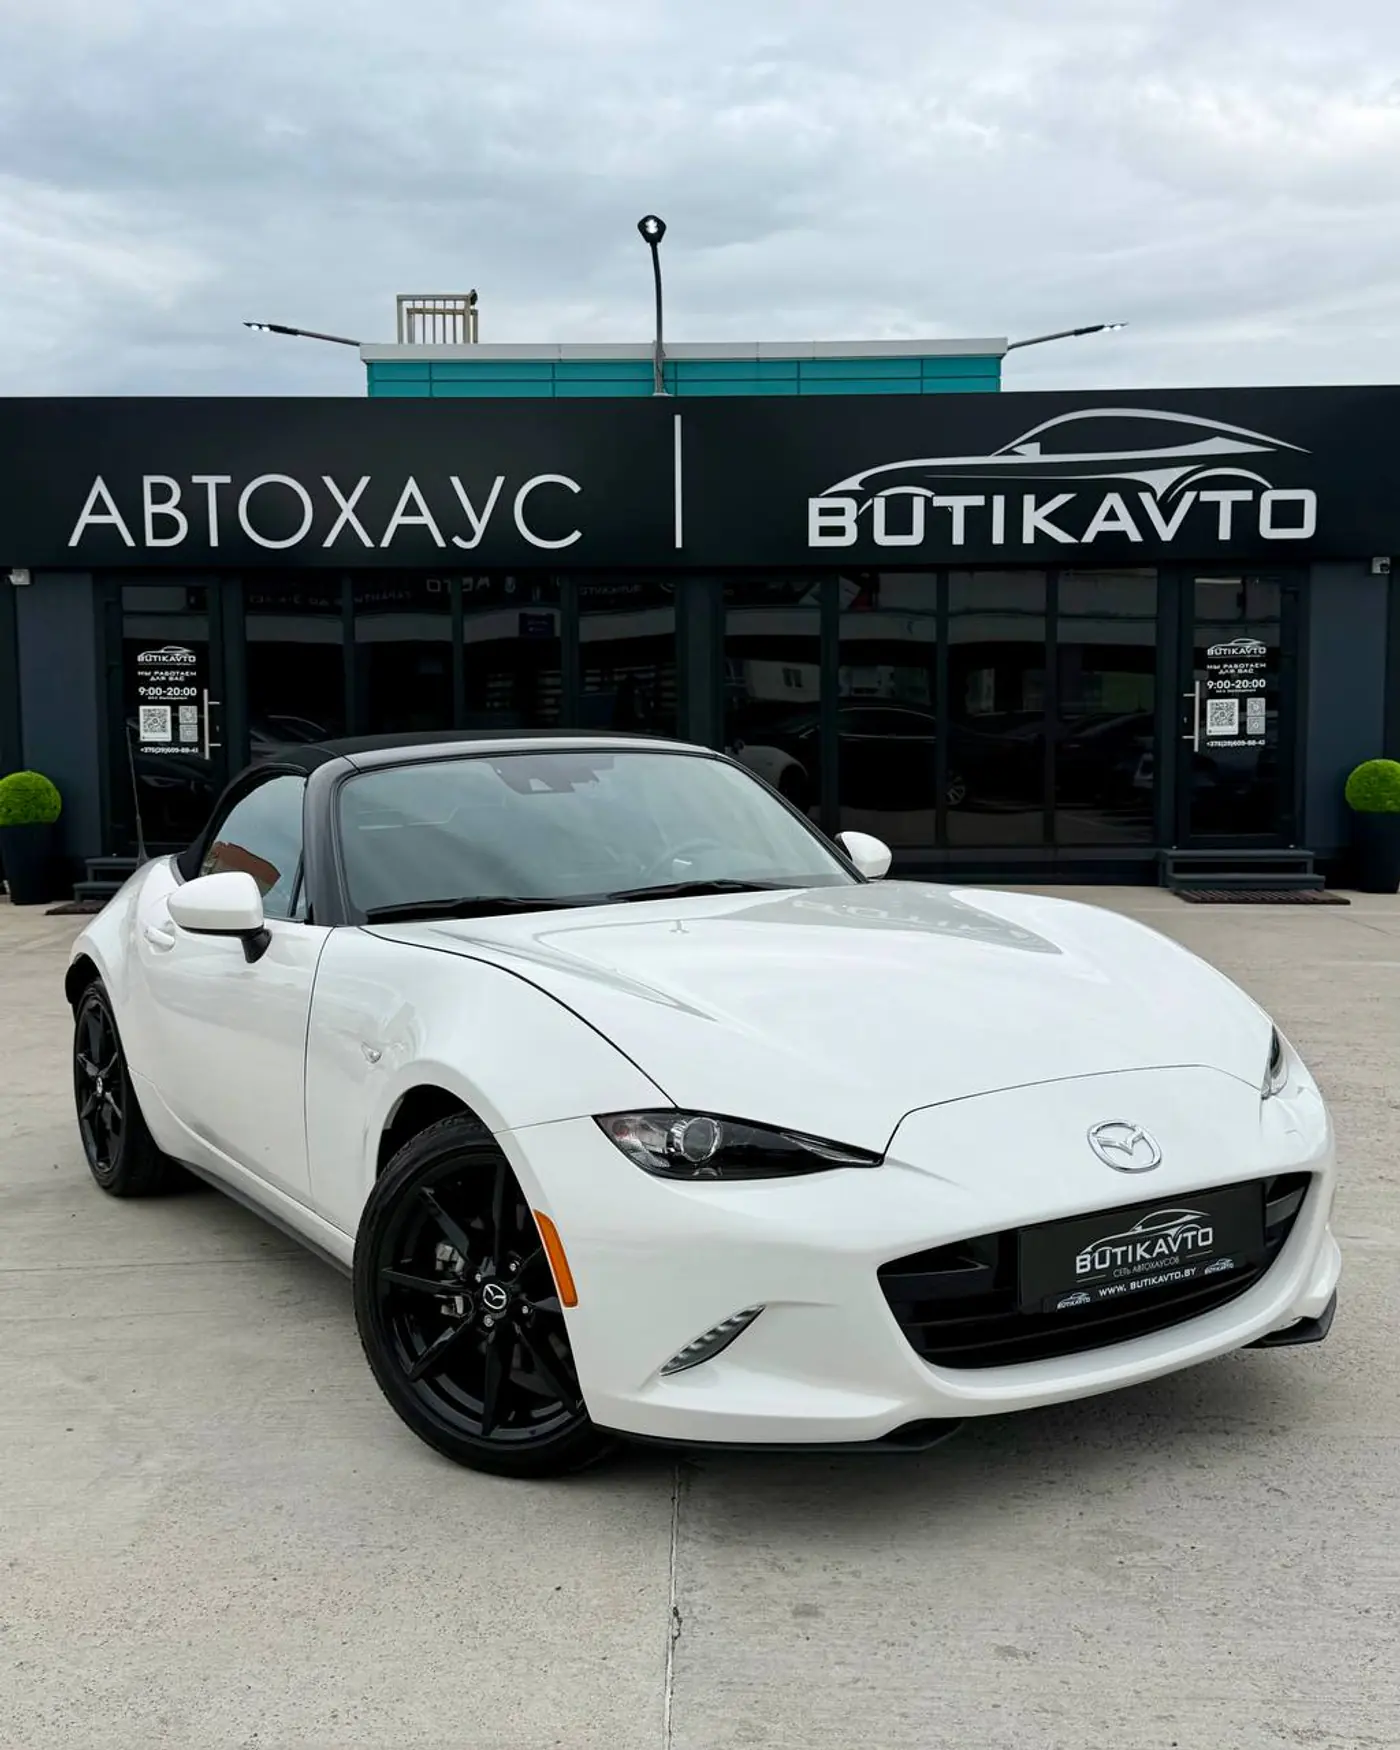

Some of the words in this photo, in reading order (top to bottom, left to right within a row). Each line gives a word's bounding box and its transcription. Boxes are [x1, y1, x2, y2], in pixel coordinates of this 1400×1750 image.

[69, 474, 581, 549] АВТОХАУС
[808, 488, 1317, 547] BUTIKAVTO
[1207, 647, 1267, 656] BUTIKAVTO
[138, 686, 198, 697] 9:00-20:00
[1206, 679, 1267, 690] 9:00-20:00
[1075, 1227, 1213, 1275] BUTIKAVTO
[1130, 1267, 1196, 1290] BUTIKAVTO.BY
